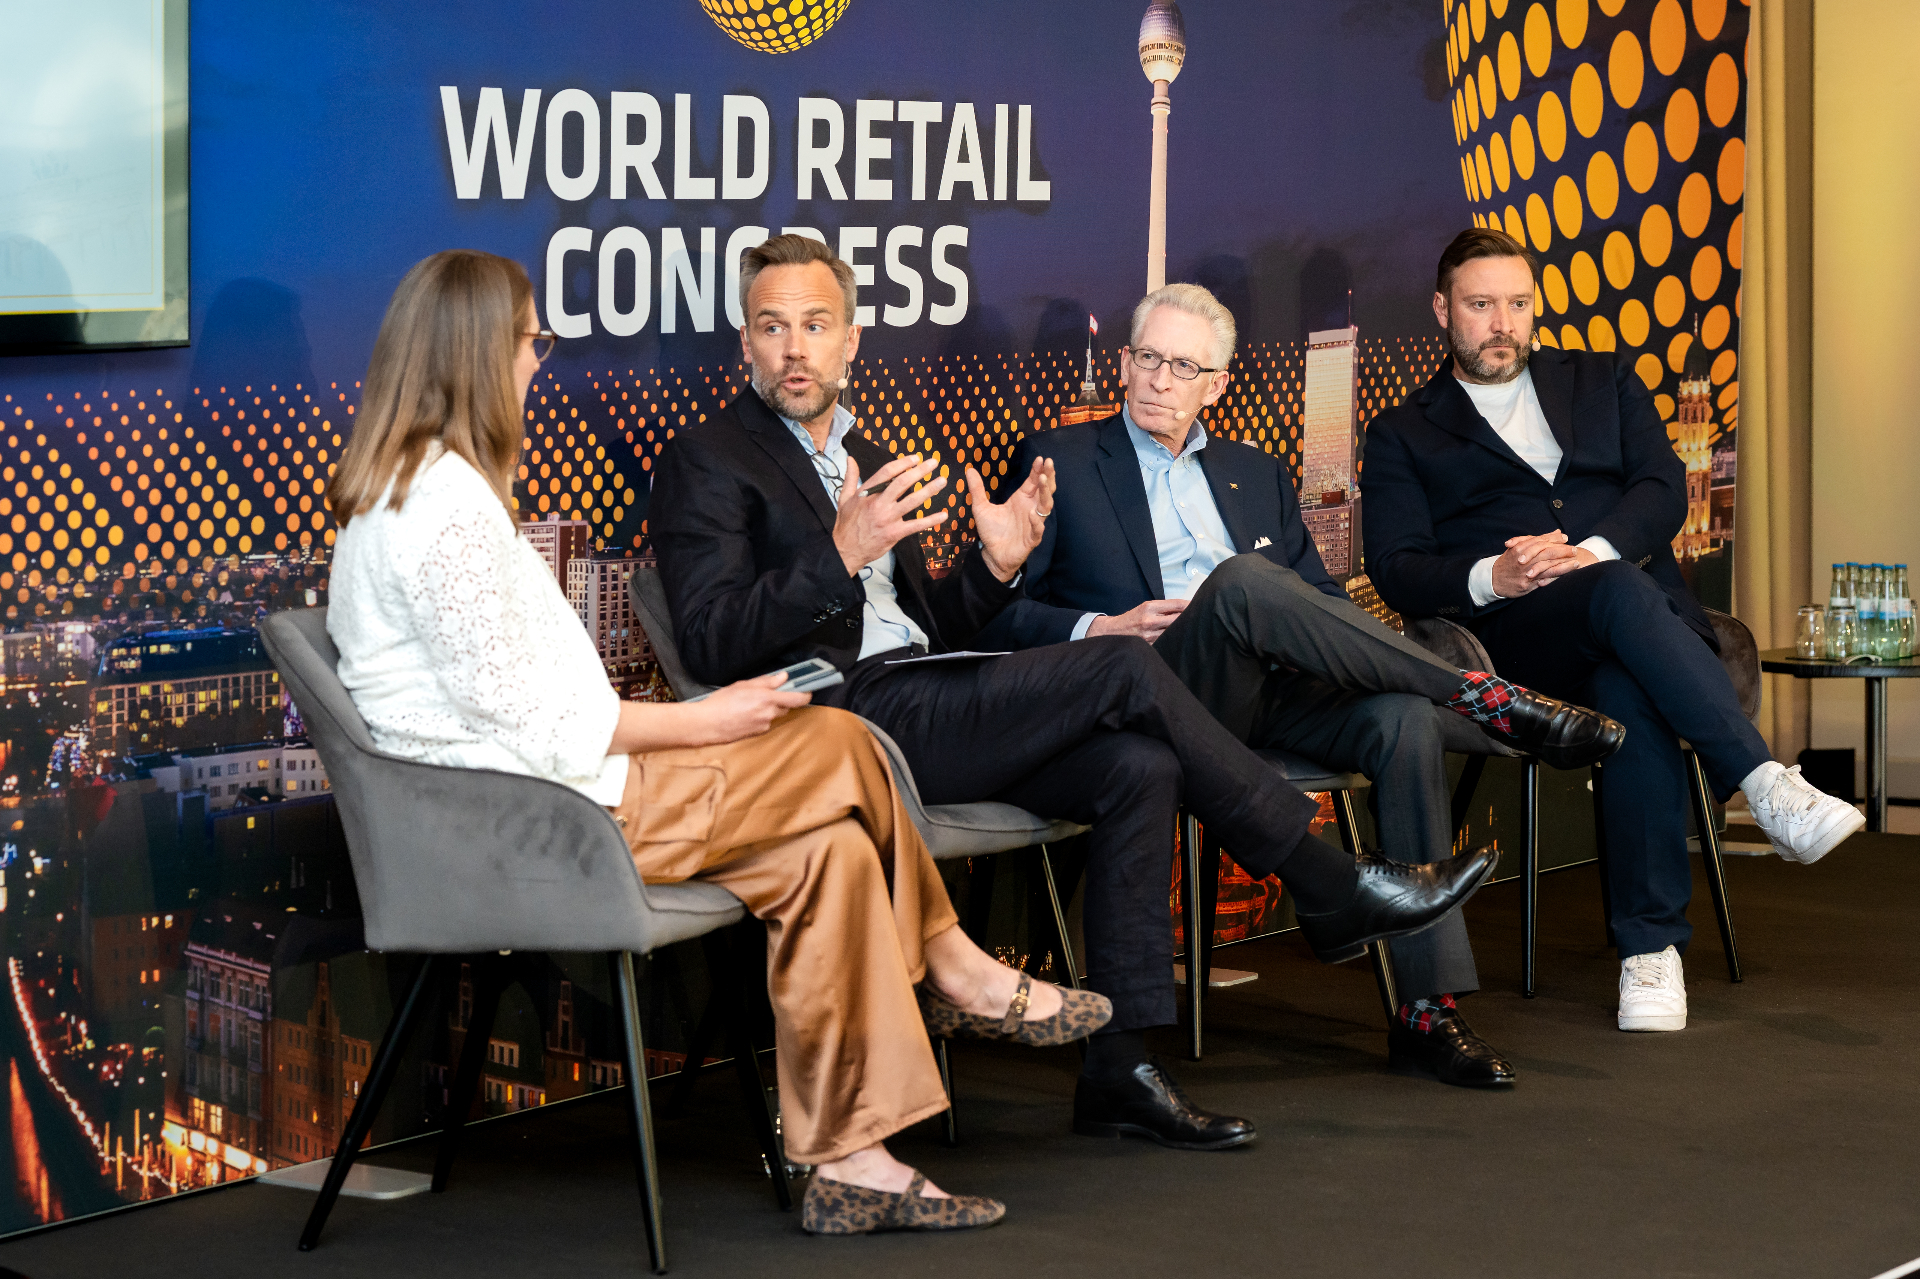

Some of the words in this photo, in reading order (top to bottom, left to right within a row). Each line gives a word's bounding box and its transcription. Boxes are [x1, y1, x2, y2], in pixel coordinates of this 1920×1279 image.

[440, 86, 769, 201] WORLD
[798, 97, 1050, 200] RETAIL
[546, 225, 968, 338] CONESS
